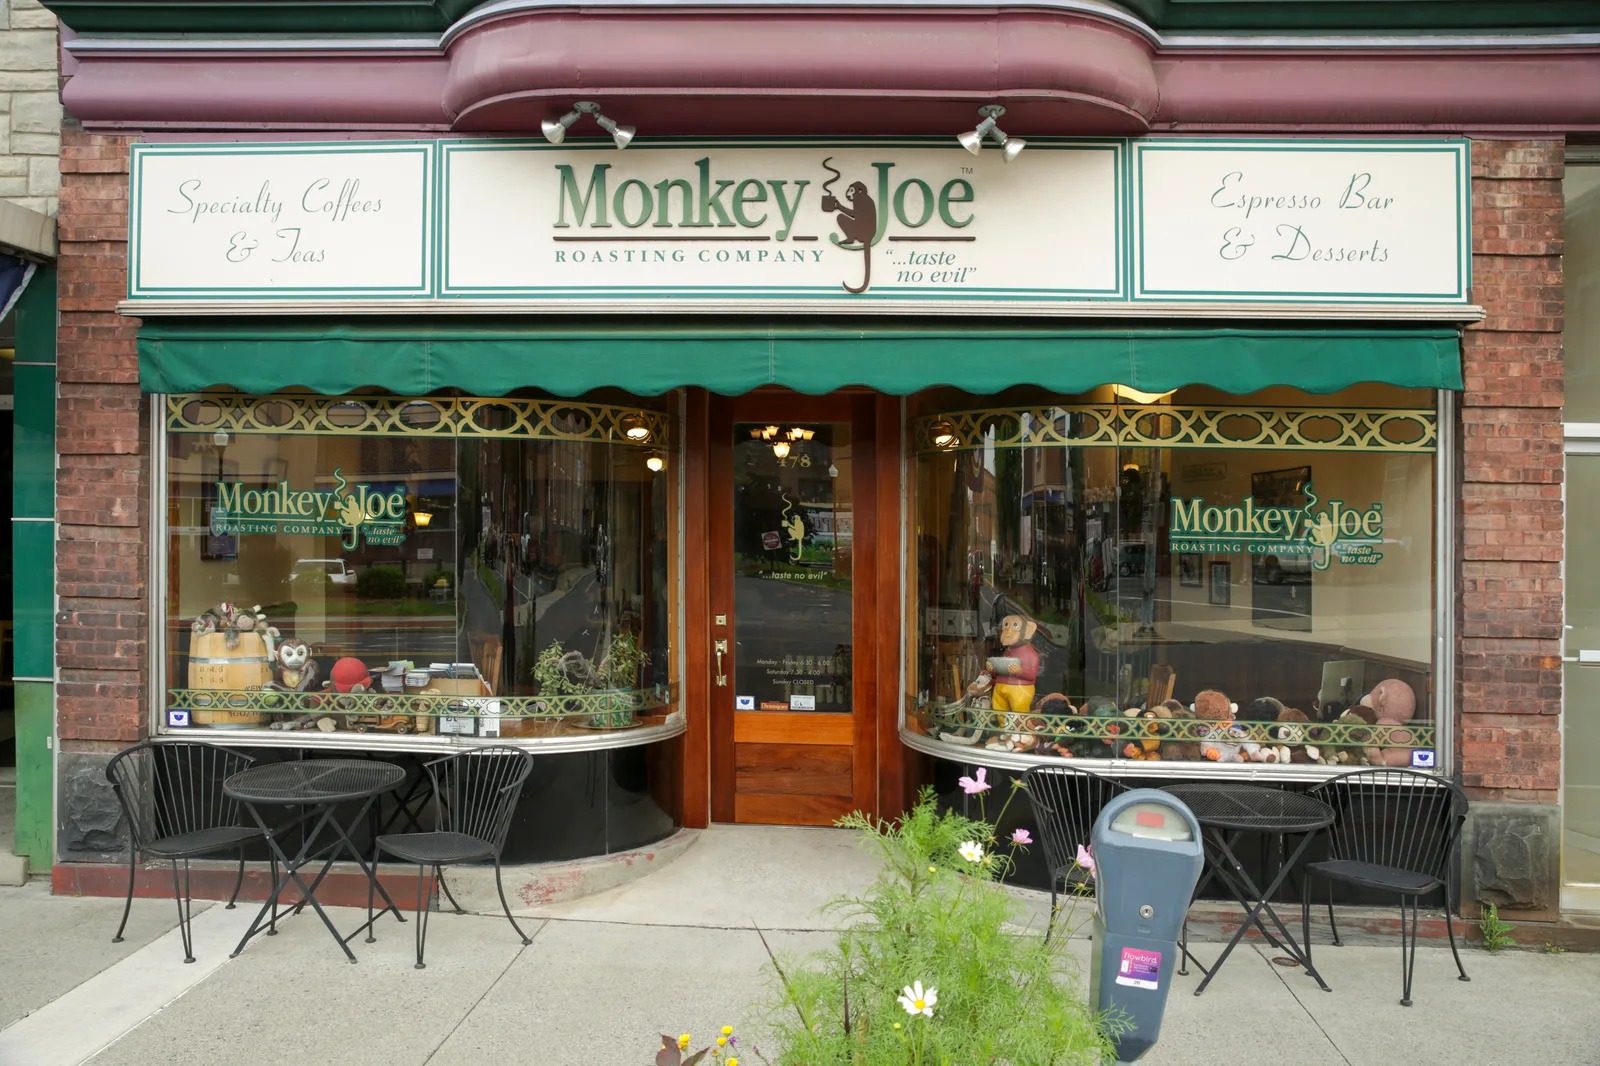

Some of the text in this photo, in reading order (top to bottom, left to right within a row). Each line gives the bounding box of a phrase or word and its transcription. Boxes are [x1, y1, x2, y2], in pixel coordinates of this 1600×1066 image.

[960, 167, 974, 175] TM
[167, 178, 382, 223] Specialty Coffees
[1211, 171, 1394, 219] Espresso Bar
[553, 157, 975, 250] Monkey Joe
[226, 227, 325, 263] & Teas
[1219, 224, 1389, 262] & Desserts
[555, 249, 824, 263] ROASTING COMPANY
[897, 269, 923, 283] no
[216, 480, 404, 528] Monkey Joe
[1172, 497, 1382, 546] Monkey Joe
[216, 523, 343, 535] ROASTING COMPANY
[1172, 543, 1313, 554] ROASTING COMPANY
[1341, 555, 1355, 563] no
[766, 668, 791, 676] Saturday
[772, 678, 791, 686] Sunday
